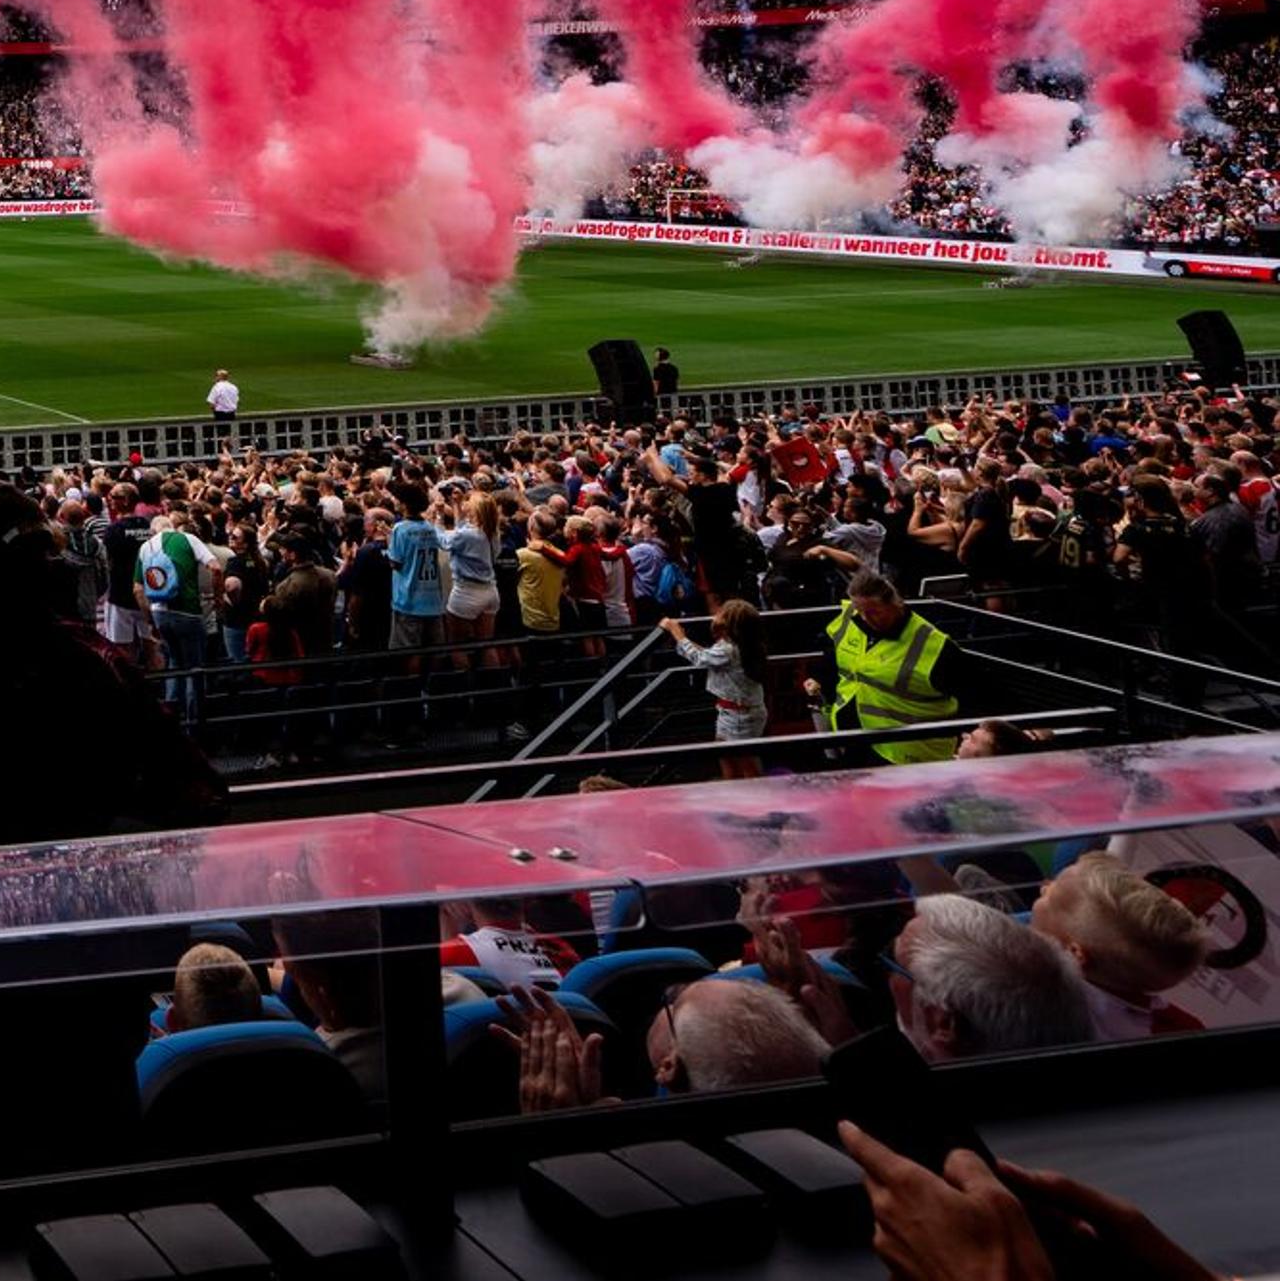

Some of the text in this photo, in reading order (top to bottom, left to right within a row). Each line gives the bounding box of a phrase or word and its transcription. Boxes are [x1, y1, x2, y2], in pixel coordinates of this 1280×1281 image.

[21, 202, 77, 217] wasdroger
[576, 222, 654, 241] wasdroger
[844, 238, 931, 257] wanneer
[934, 242, 969, 260] het
[971, 244, 1006, 262] jou
